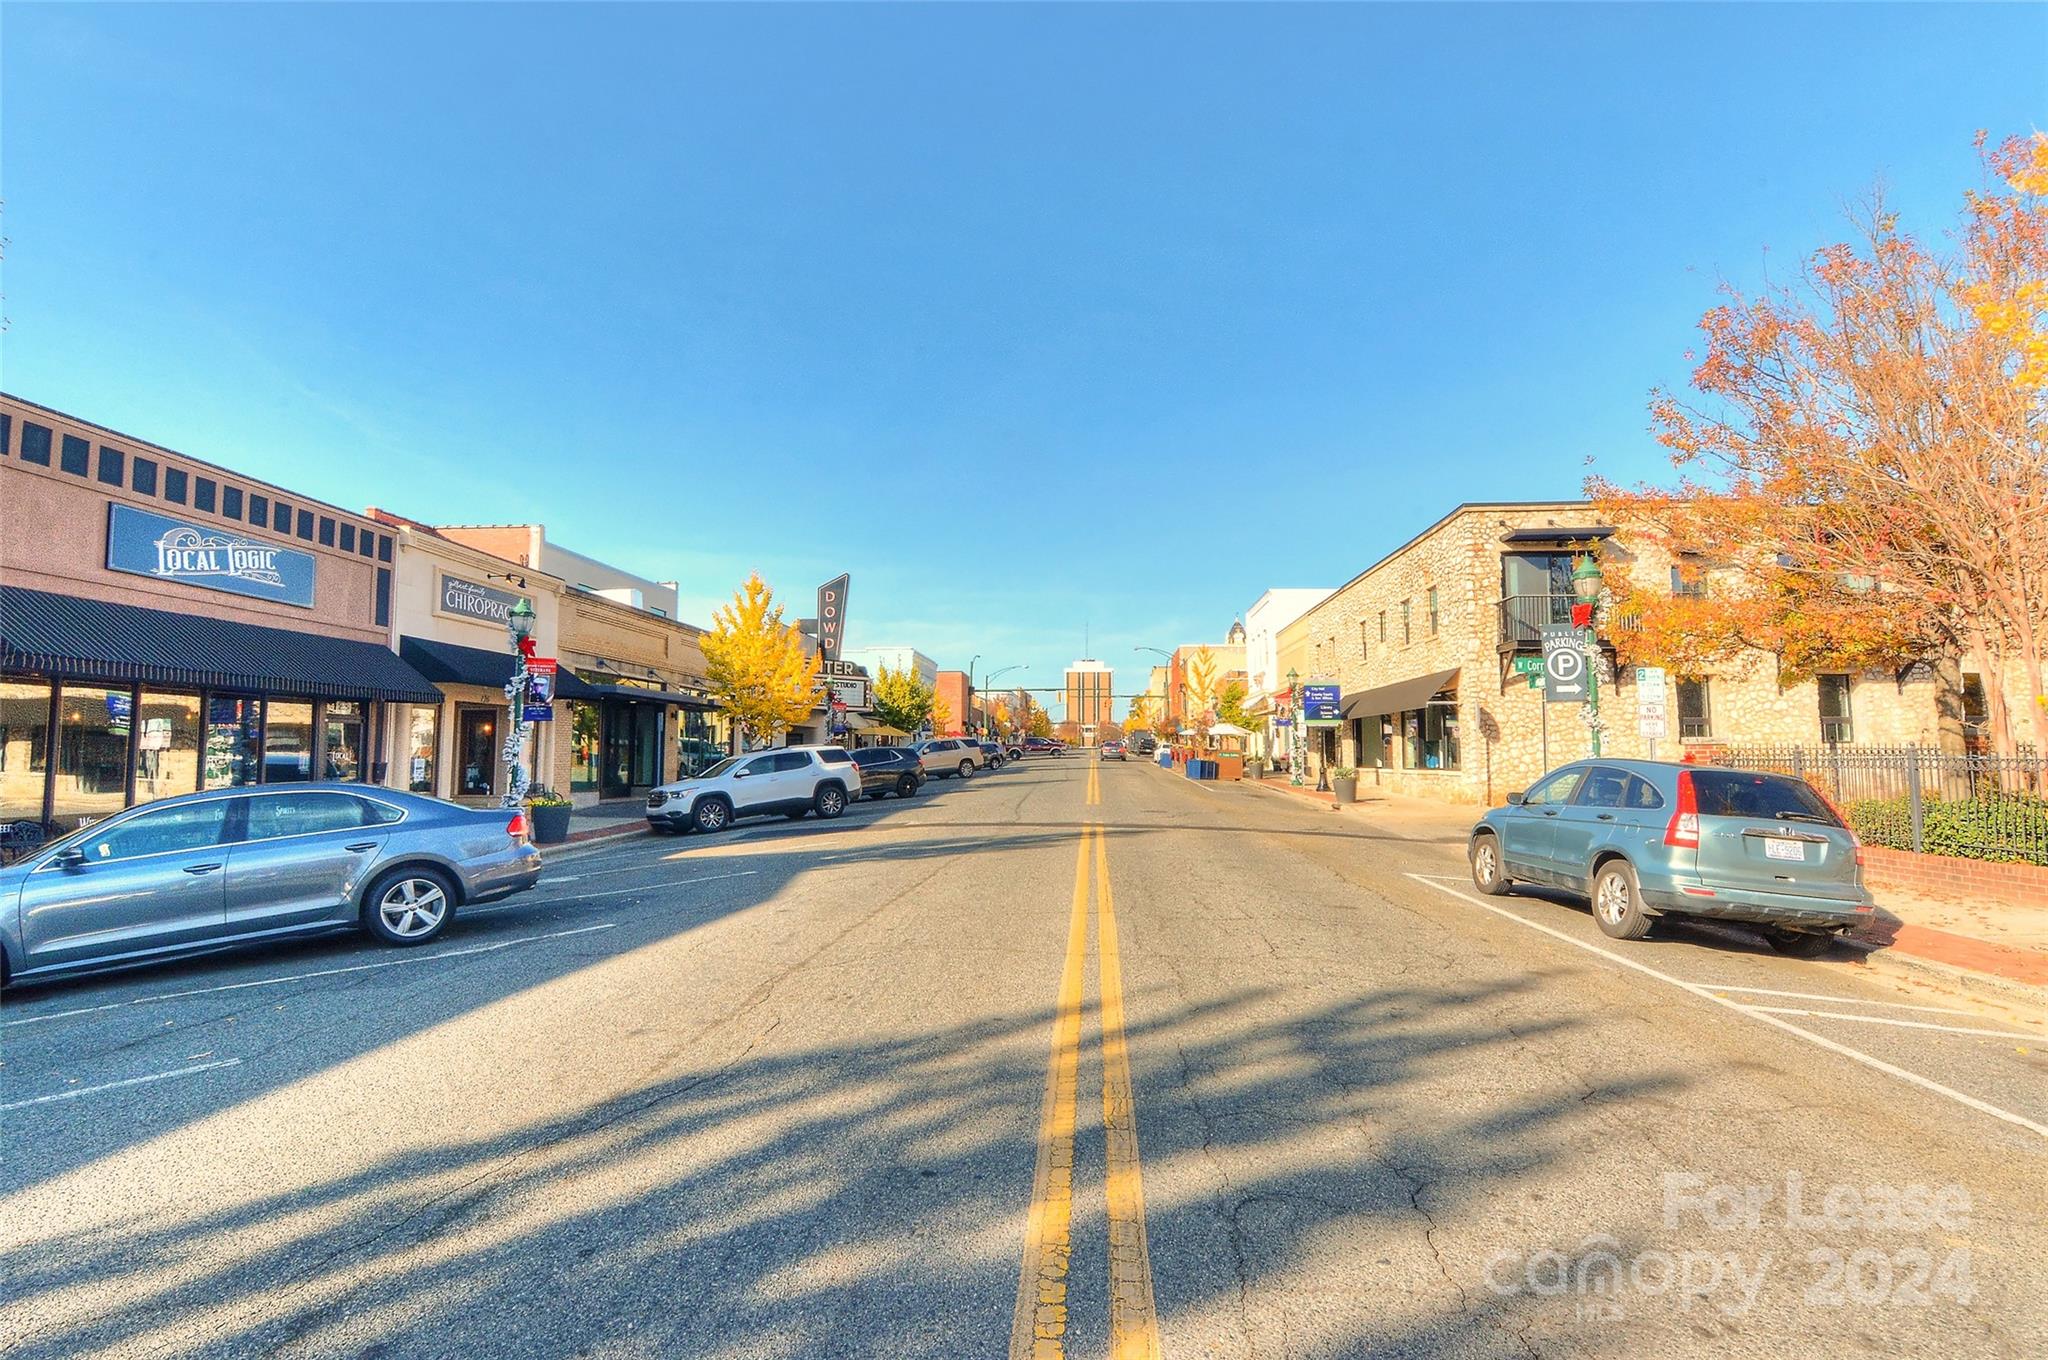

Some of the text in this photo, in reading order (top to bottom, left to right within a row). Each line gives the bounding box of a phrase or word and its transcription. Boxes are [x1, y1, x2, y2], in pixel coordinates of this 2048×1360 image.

[154, 540, 277, 577] LOCAL LOGIC
[823, 591, 838, 649] DOWD
[1543, 630, 1584, 638] PUBLIC
[1544, 637, 1585, 652] PARKING
[1558, 655, 1574, 675] P
[1638, 670, 1645, 679] 2
[835, 681, 857, 689] STUDIO
